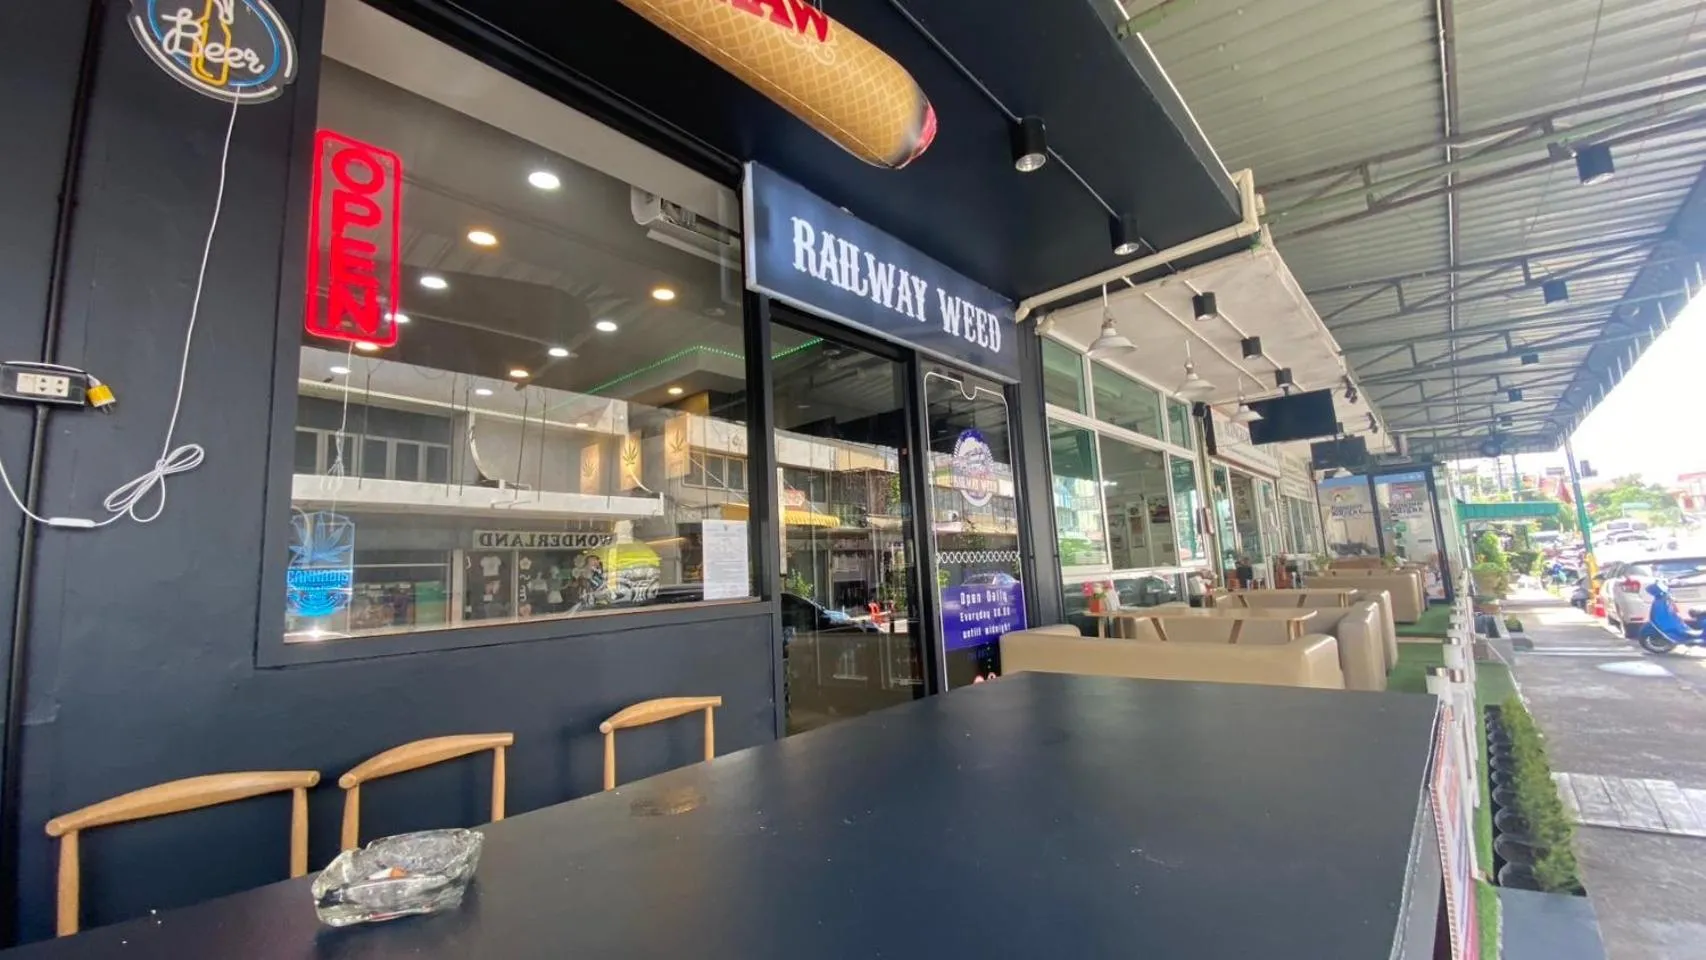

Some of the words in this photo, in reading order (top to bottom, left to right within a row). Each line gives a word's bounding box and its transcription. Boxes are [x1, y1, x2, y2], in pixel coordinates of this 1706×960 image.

[160, 7, 266, 75] Beer
[731, 0, 829, 43] AW
[328, 147, 386, 334] OPEN
[790, 216, 929, 323] RAILWAY
[936, 287, 1002, 354] WEED
[959, 591, 982, 607] Open
[985, 588, 1009, 603] Daily
[959, 609, 991, 623] Everyday
[984, 622, 1012, 637] midnight
